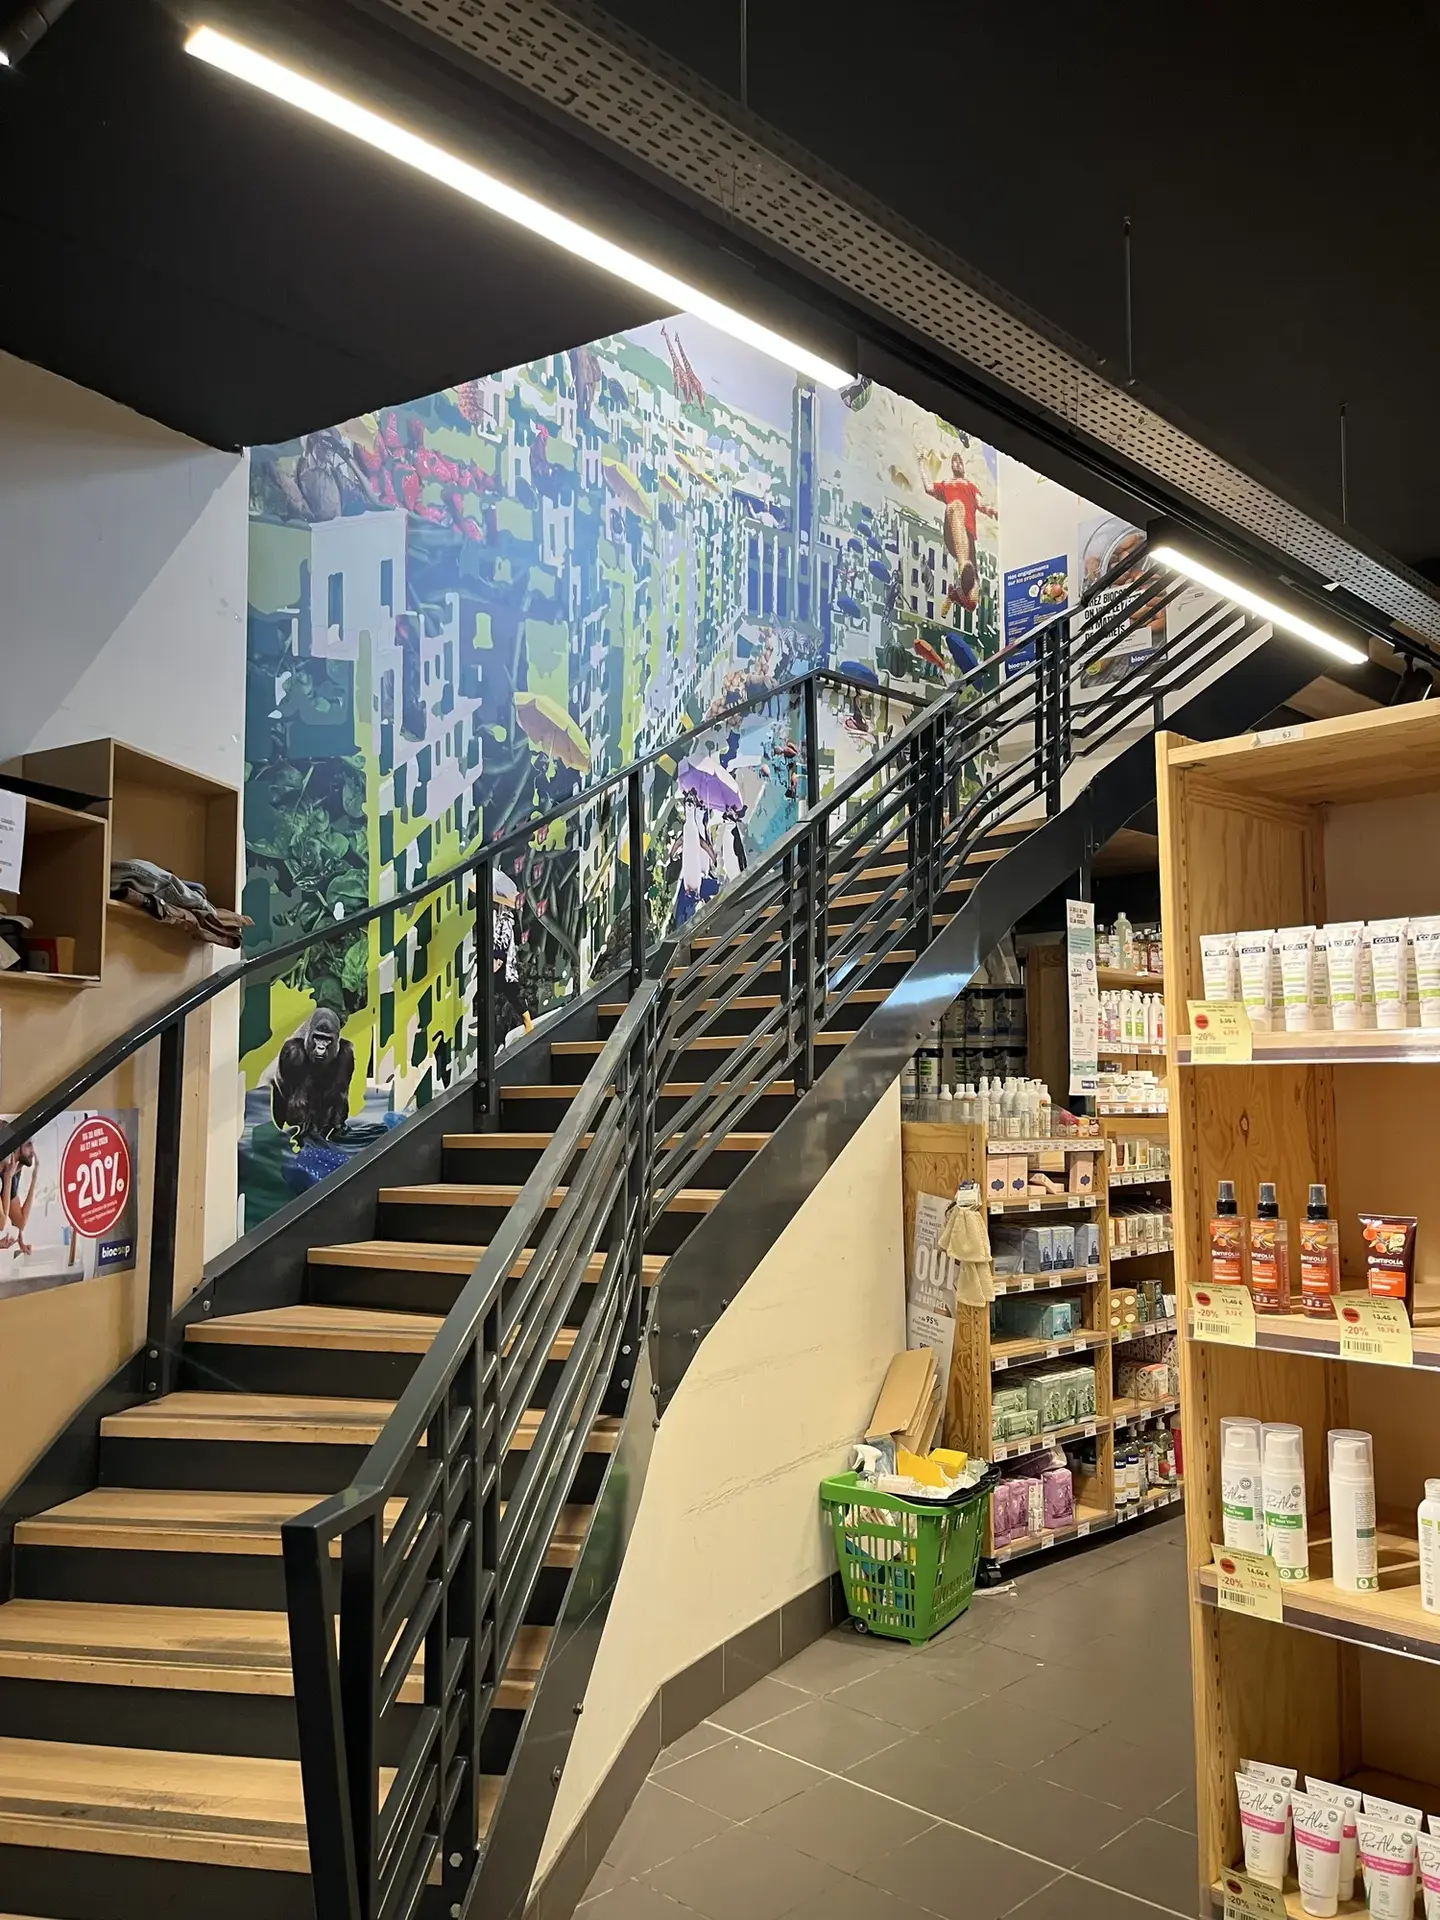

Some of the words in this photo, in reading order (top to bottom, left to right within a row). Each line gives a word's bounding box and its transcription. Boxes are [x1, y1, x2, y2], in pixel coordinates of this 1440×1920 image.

[1195, 1033, 1216, 1041] -20%
[101, 1245, 131, 1259] biocoop
[915, 1245, 955, 1290] OUI
[1197, 1308, 1219, 1319] -20%
[1344, 1325, 1369, 1336] -20%
[1222, 1576, 1244, 1588] -20%
[1227, 1895, 1250, 1910] -20%
